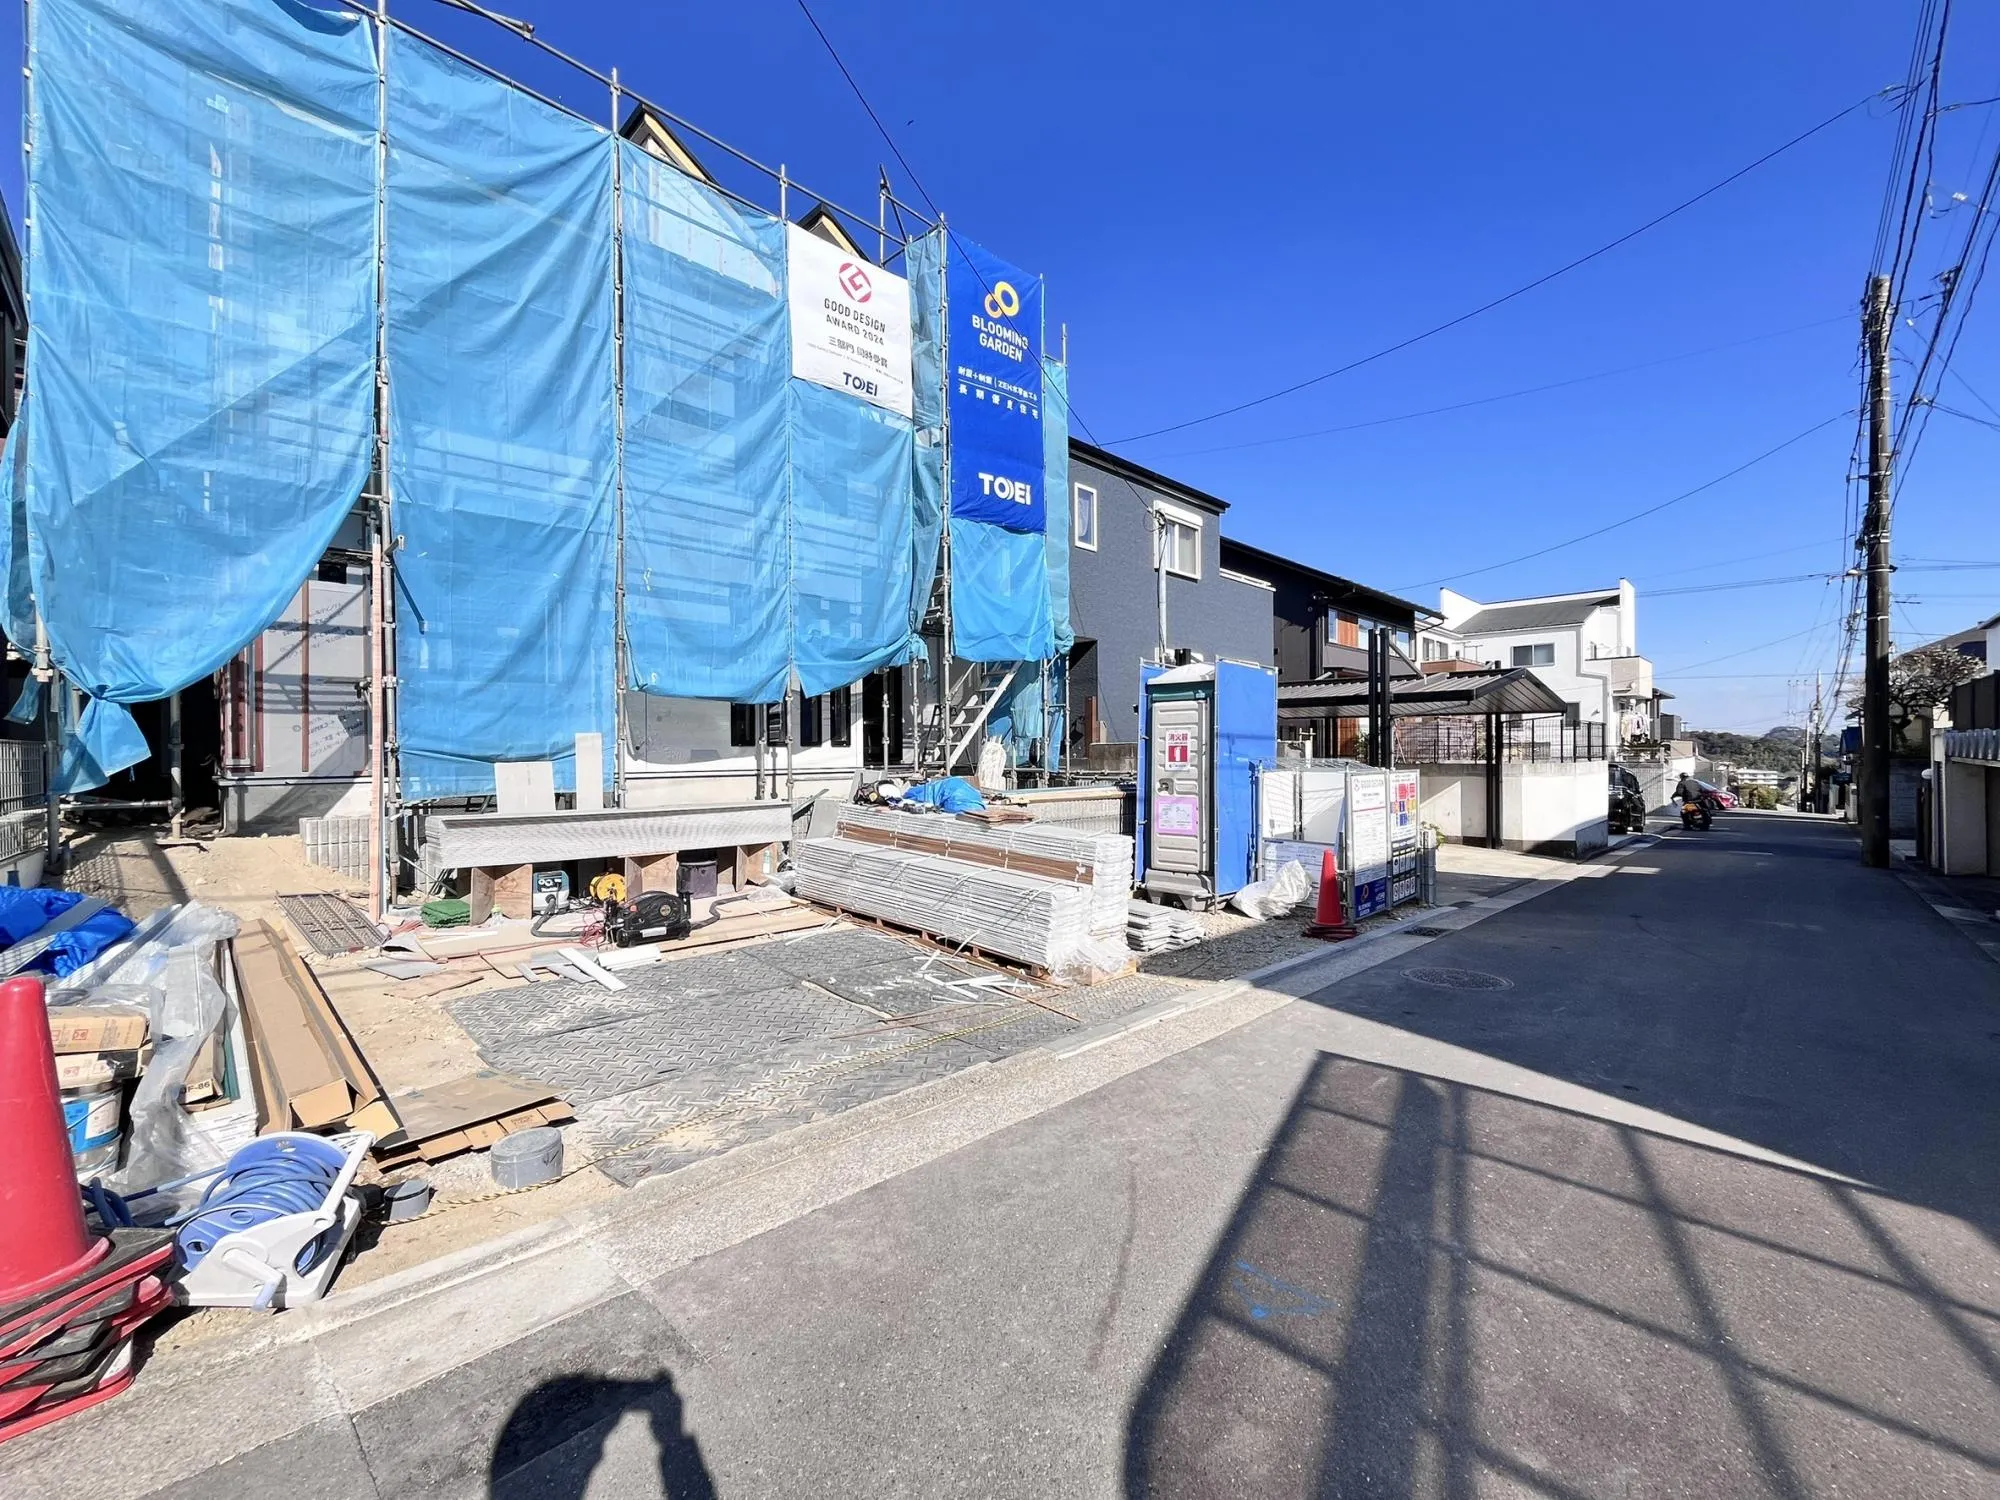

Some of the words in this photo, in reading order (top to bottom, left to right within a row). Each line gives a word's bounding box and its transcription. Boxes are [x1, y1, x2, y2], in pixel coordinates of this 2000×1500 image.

[824, 298, 851, 317] GOOD
[853, 310, 886, 333] DESIGN
[826, 314, 860, 335] AWARD
[862, 328, 885, 346] 2024
[971, 314, 1029, 350] BLOOMING
[979, 332, 1023, 362] GARDEN
